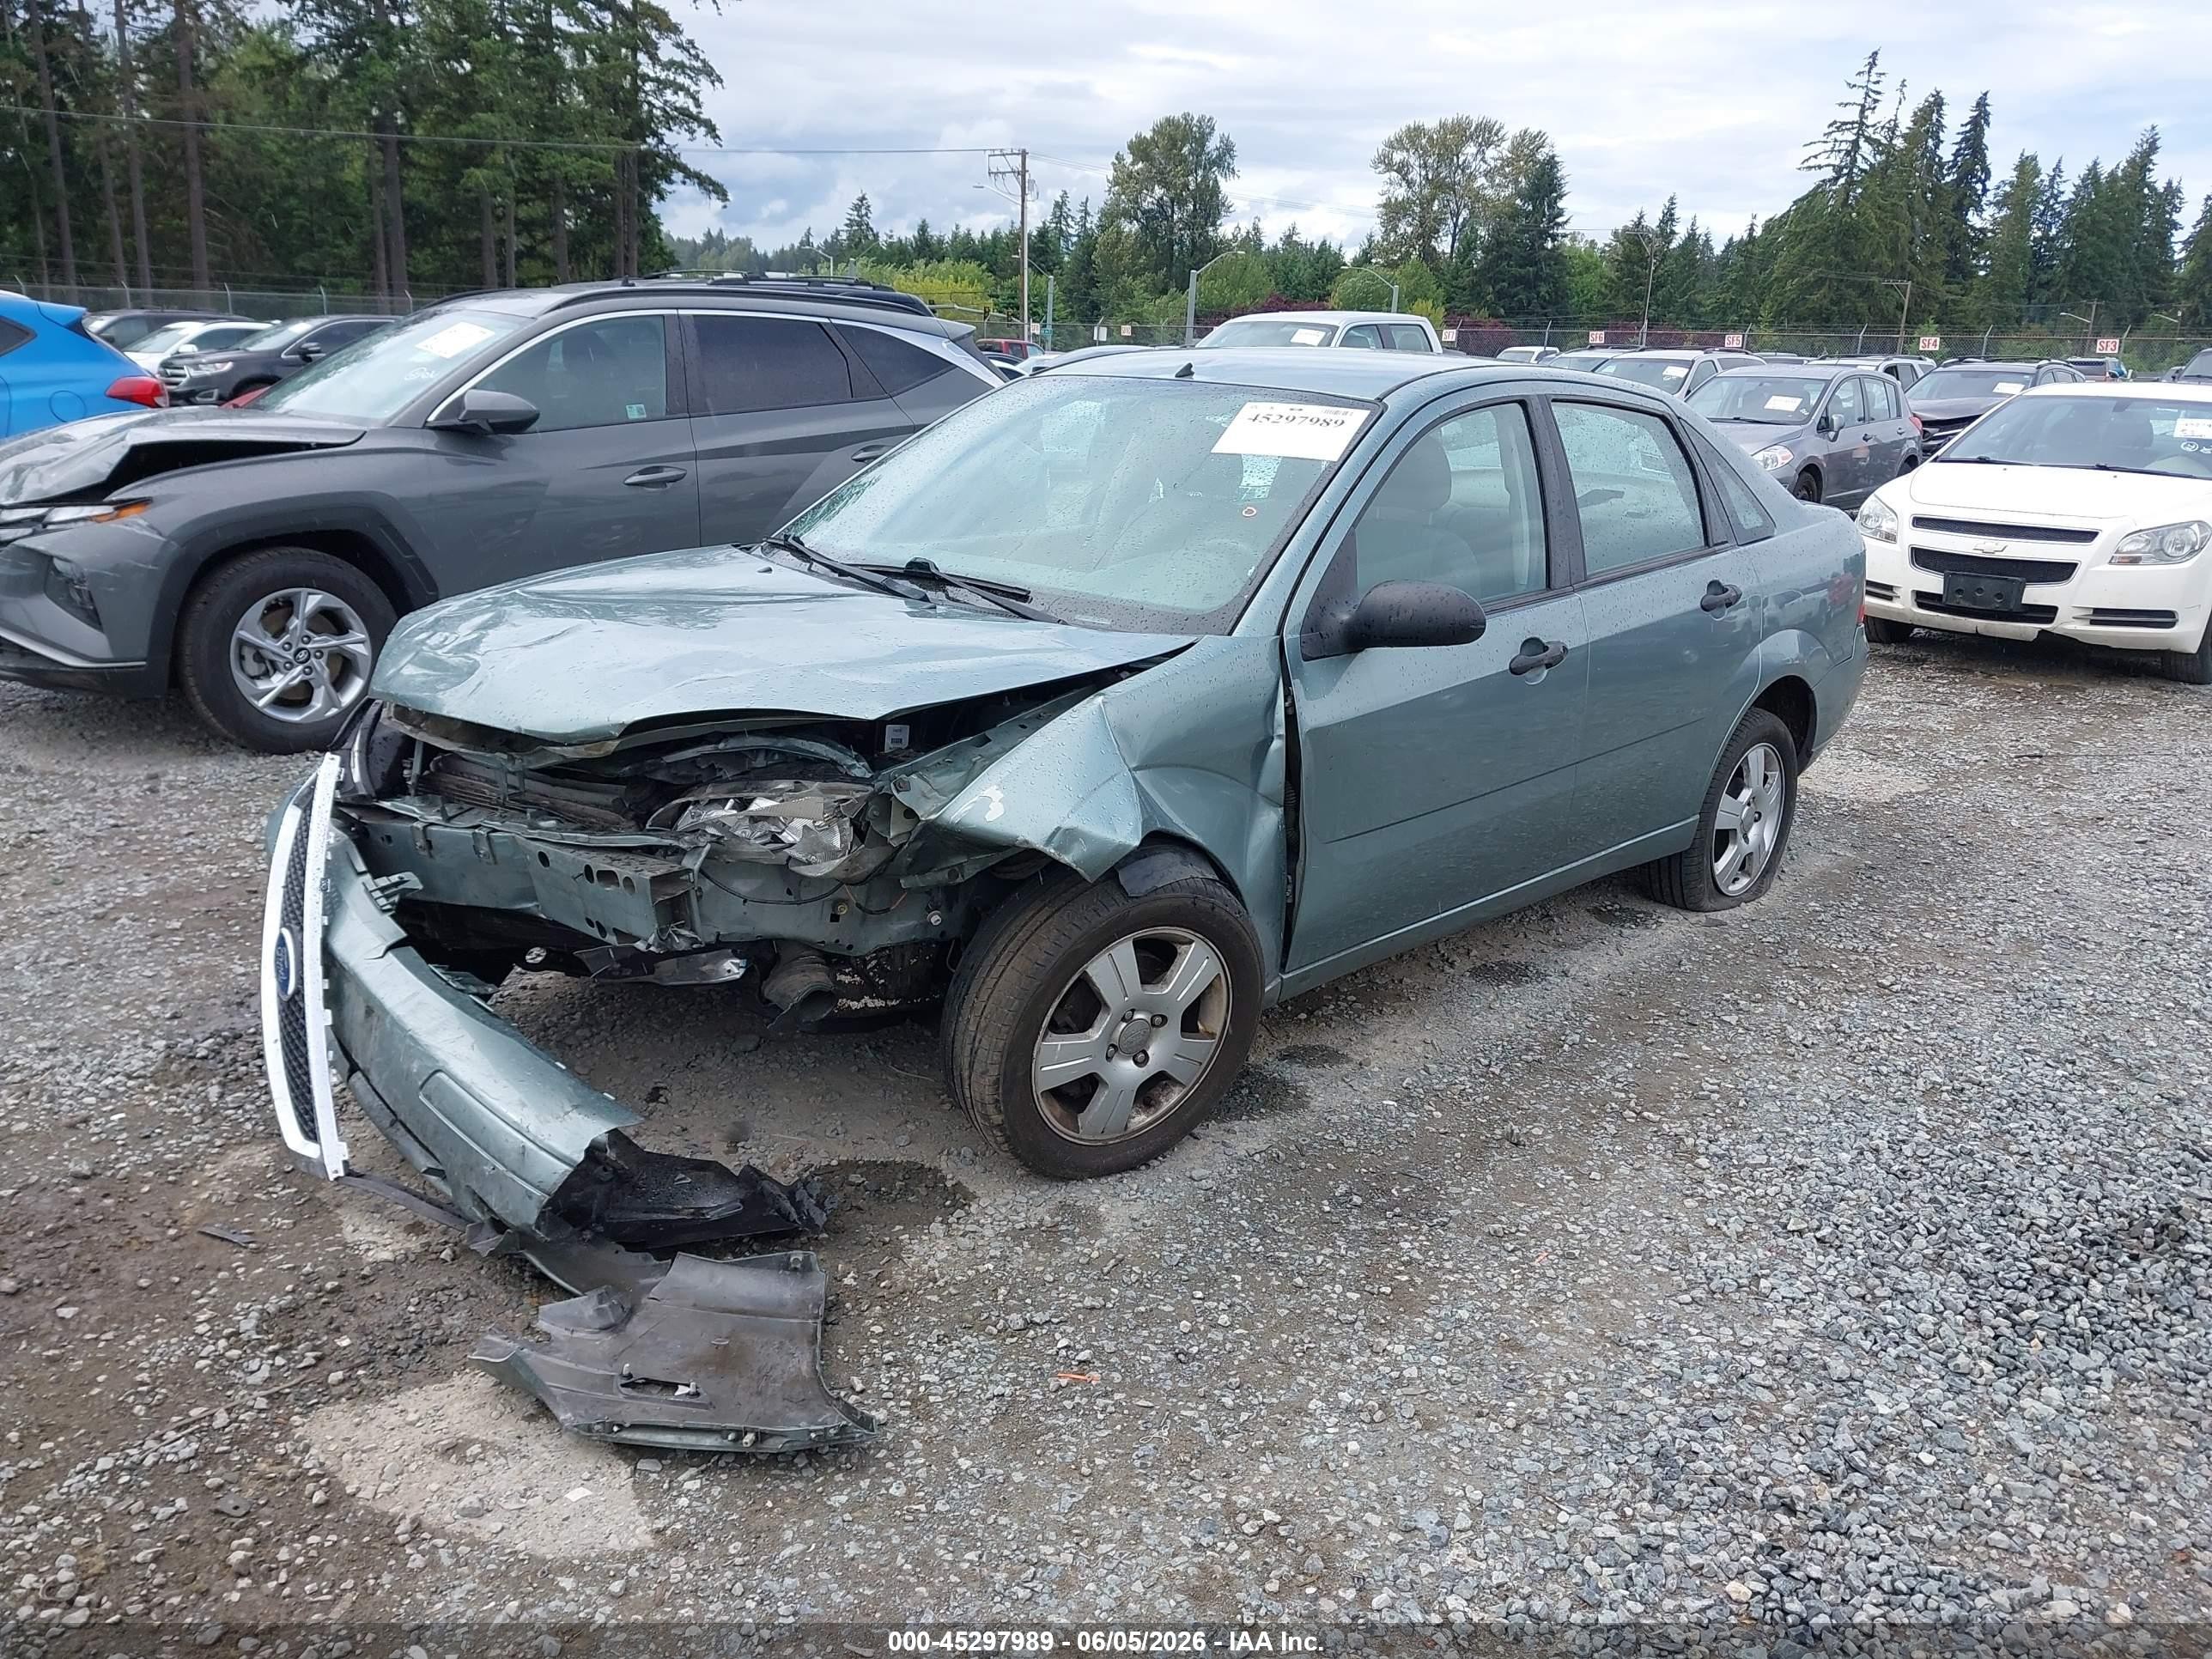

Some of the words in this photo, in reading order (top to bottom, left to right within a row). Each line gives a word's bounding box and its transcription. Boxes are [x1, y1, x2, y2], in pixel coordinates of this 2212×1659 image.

[1726, 336, 1741, 346] SF5
[1921, 338, 1938, 349] SF4
[2098, 340, 2118, 352] SF3
[1248, 413, 1346, 427] 45297989
